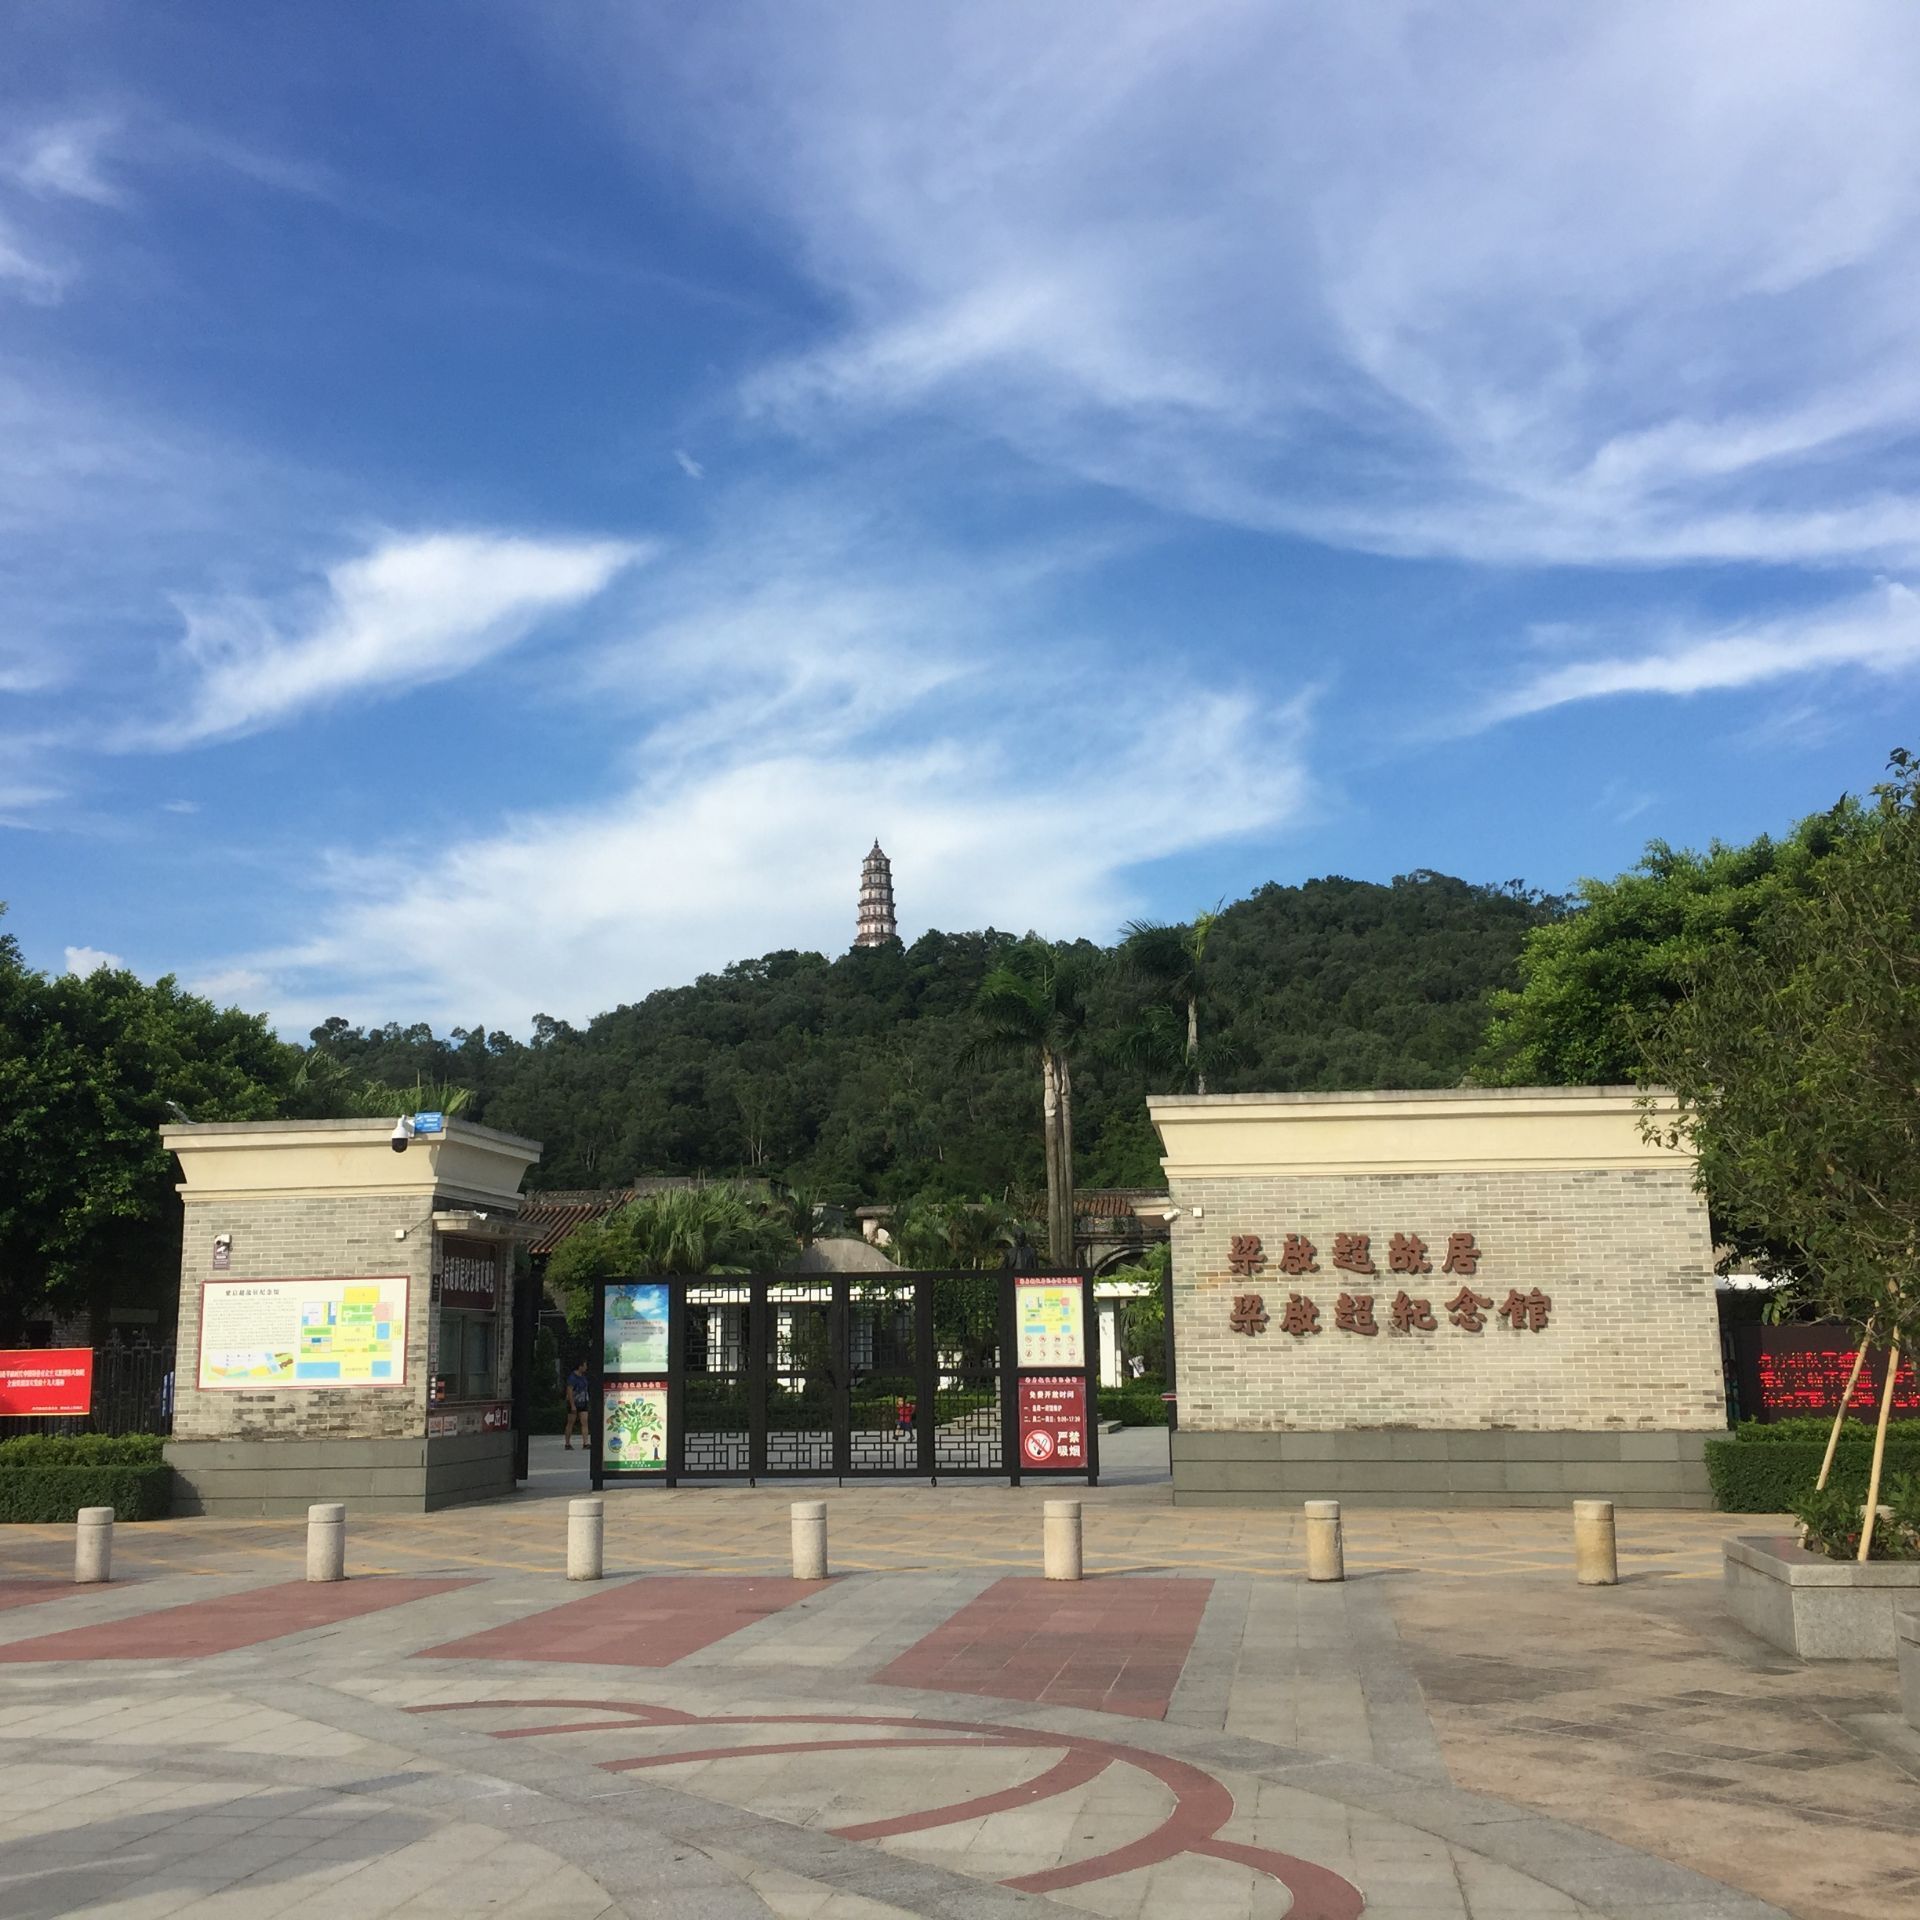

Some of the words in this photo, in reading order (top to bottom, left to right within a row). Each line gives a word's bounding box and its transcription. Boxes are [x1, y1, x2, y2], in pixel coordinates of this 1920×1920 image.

[1228, 1232, 1481, 1276] 梁啟超故居
[1230, 1286, 1552, 1337] 梁啟超紀念館
[1029, 1390, 1075, 1399] 免费开放时间
[494, 1407, 508, 1426] 出口
[1057, 1431, 1081, 1443] 严禁
[1057, 1445, 1081, 1457] 吸烟
